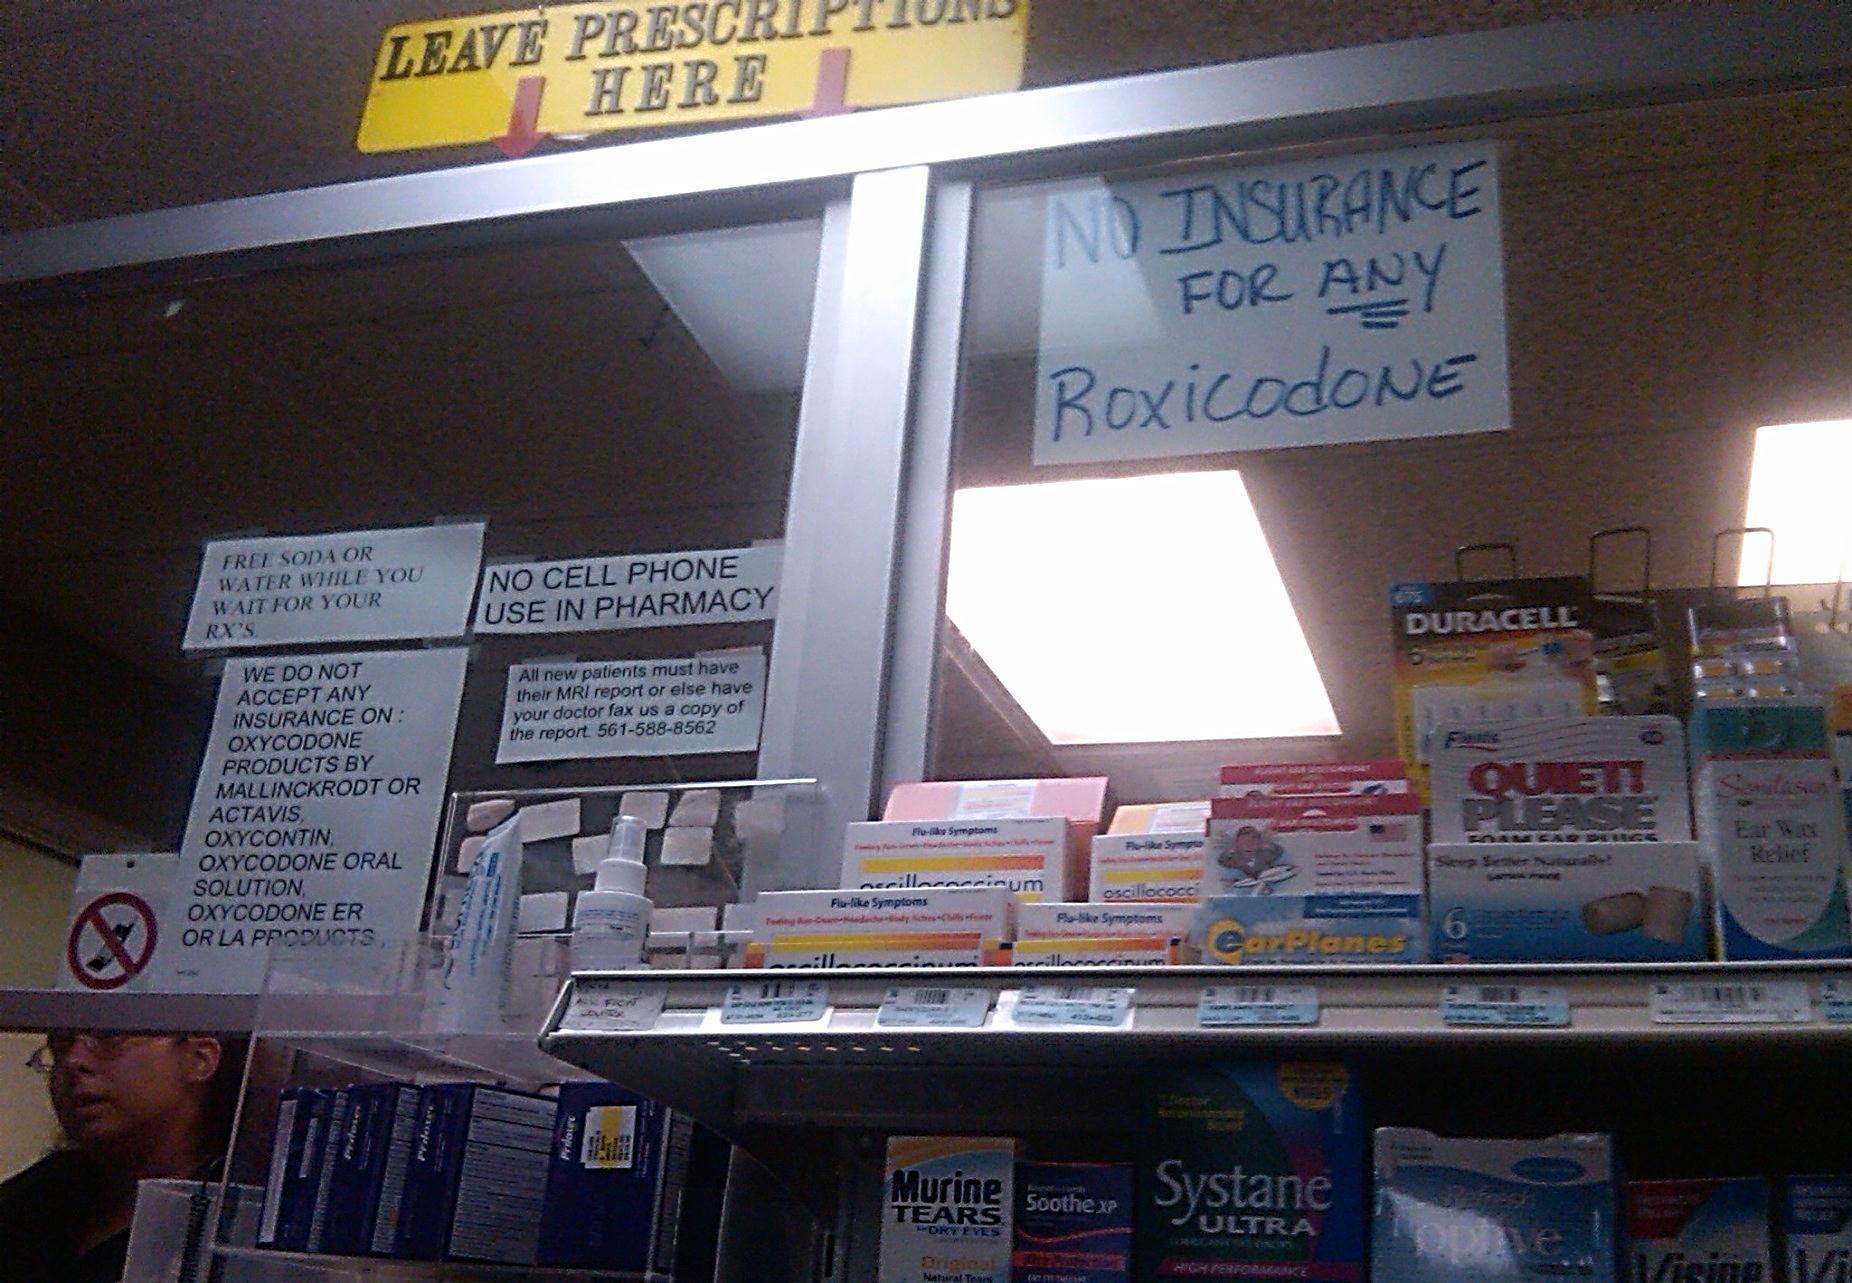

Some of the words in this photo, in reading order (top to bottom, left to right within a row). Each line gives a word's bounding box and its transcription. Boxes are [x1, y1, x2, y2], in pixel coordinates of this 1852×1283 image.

[380, 19, 549, 80] LEAVE
[585, 54, 769, 117] HERE
[1053, 190, 1140, 268] NO
[1159, 160, 1487, 256] INSURANCE
[1177, 262, 1294, 314] FOR
[1318, 242, 1446, 313] ANY
[223, 552, 274, 571] FREE
[280, 549, 336, 567] SODA
[343, 546, 373, 562] OR
[218, 573, 292, 593] WATER
[299, 569, 368, 588] WHILE
[377, 567, 424, 584] YOU
[489, 569, 533, 593] NO
[543, 564, 617, 590] CELL
[628, 555, 740, 584] PHONE
[213, 598, 270, 616] WAIT
[273, 595, 313, 611] FOR
[321, 592, 382, 610] YOUR
[484, 601, 546, 625] USE
[555, 598, 585, 622] IN
[595, 586, 775, 620] PHARMACY
[1405, 606, 1579, 635] DURACELL
[243, 665, 275, 684] WE
[282, 664, 313, 682] DO
[318, 662, 363, 680] NOT
[519, 668, 539, 683] All
[545, 670, 577, 681] new
[581, 664, 647, 683] patients
[651, 662, 693, 677] must
[699, 660, 740, 674] have
[237, 687, 322, 705] ACCEPT
[327, 684, 371, 702] ANY
[517, 688, 551, 702] their
[557, 685, 588, 700] MRI
[594, 683, 643, 702] report
[650, 685, 664, 697] or
[671, 681, 706, 695] else
[711, 679, 753, 694] have
[233, 708, 354, 729] INSURANCE
[361, 707, 393, 724] ON
[513, 710, 548, 725] your
[553, 704, 602, 720] doctor
[608, 703, 633, 717] fax
[639, 703, 659, 716] us
[664, 704, 675, 716] a
[680, 701, 722, 720] copy
[727, 700, 745, 714] of
[228, 732, 363, 752] OXYCODONE
[510, 726, 533, 741] the
[597, 720, 717, 737] 561-588-8562
[222, 756, 338, 776] PRODUCTS
[345, 755, 375, 772] BY
[216, 779, 383, 800] MALLINCKRODT
[387, 777, 421, 795] OR
[1463, 796, 1659, 832] PLEASE
[912, 827, 946, 837] Flu-like
[949, 825, 998, 837] Symptoms
[199, 853, 336, 872] OXYCODONE
[343, 852, 402, 869] ORAL
[188, 903, 326, 922] OXYCODONE
[332, 903, 363, 920] ER
[831, 897, 869, 909] Flu-like
[872, 896, 928, 910] Symptoms
[1057, 913, 1099, 923] Flu-like
[1101, 912, 1163, 926] Symptoms
[1445, 907, 1468, 940] 6
[182, 930, 212, 947] OR
[218, 929, 244, 946] LA
[891, 1169, 1001, 1204] Murine
[1155, 1159, 1332, 1226] Systane
[892, 1205, 1001, 1225] TEARS
[1026, 1193, 1094, 1213] Soothe
[1096, 1199, 1118, 1214] XP
[928, 1225, 957, 1236] DRY
[1200, 1214, 1317, 1237] ULTRA
[921, 1256, 994, 1271] Original
[923, 1272, 963, 1283] Natural
